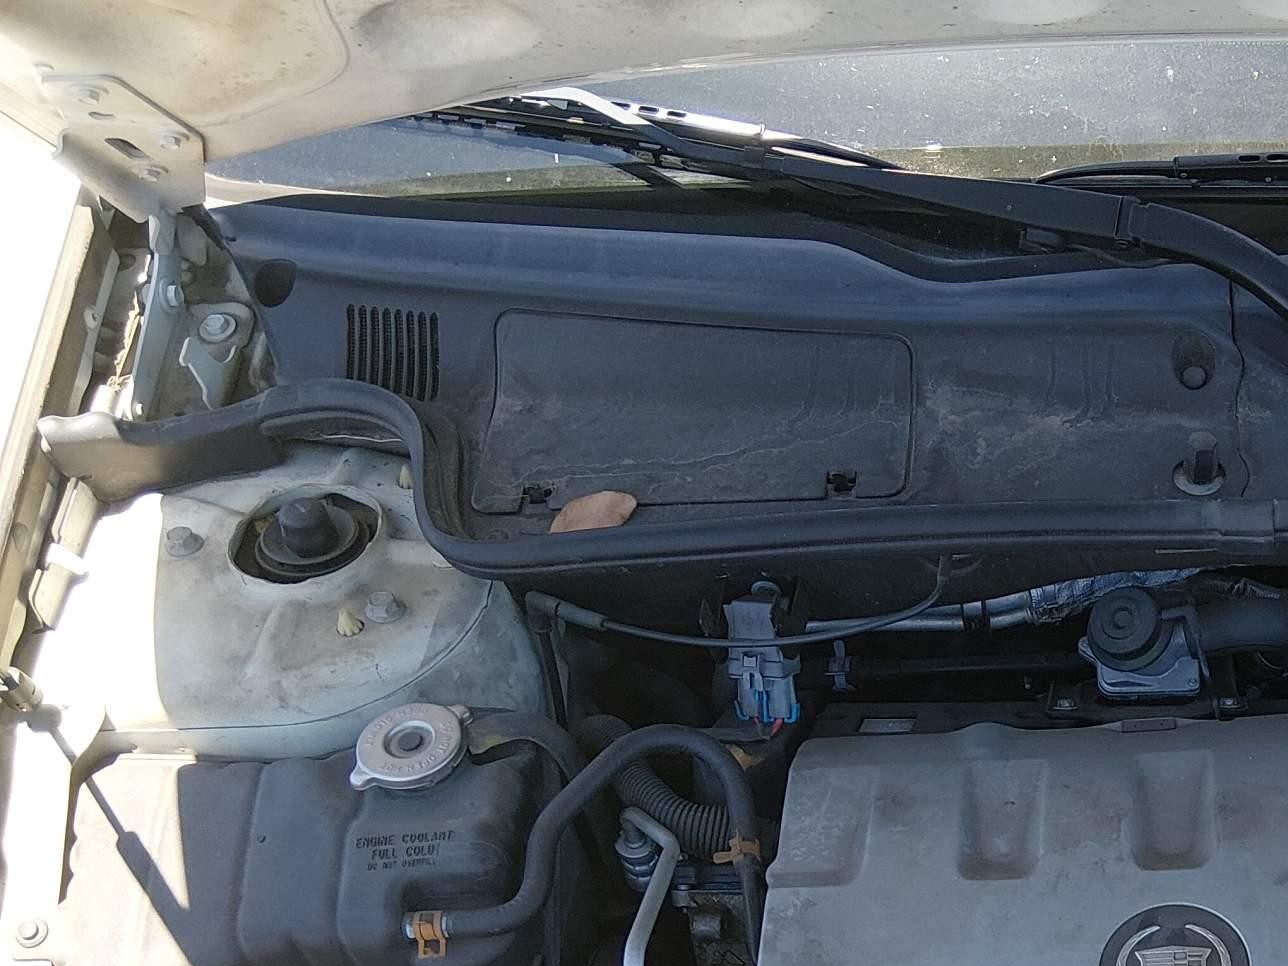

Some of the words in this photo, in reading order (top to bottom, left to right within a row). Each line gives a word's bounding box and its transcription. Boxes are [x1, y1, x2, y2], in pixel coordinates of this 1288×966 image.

[355, 834, 396, 849] ENGINE
[401, 830, 456, 844] COOLANT
[371, 847, 398, 860] FULL
